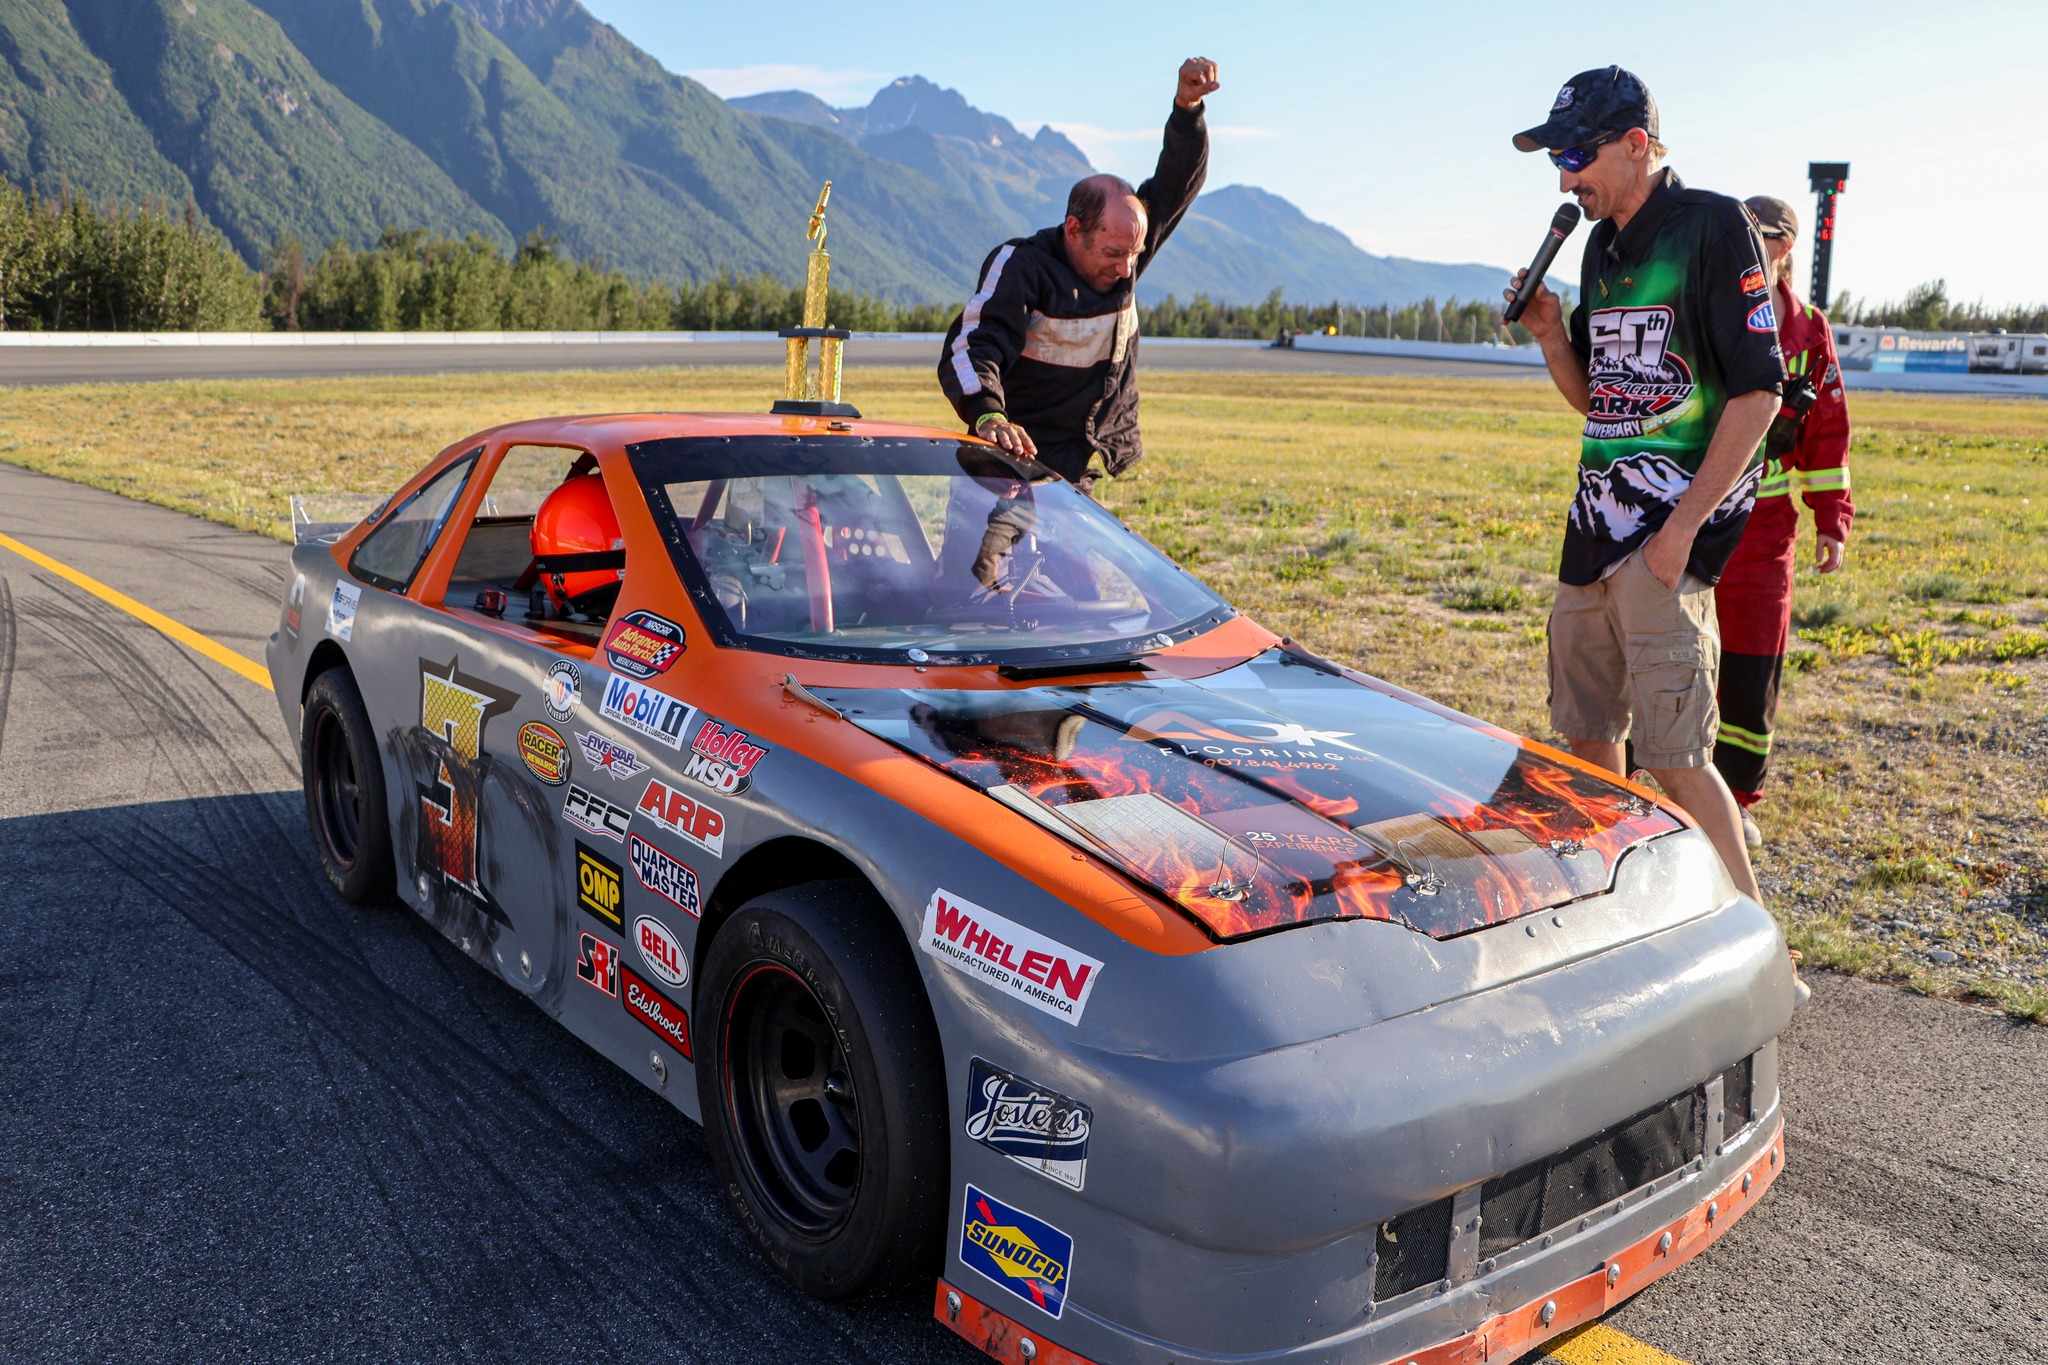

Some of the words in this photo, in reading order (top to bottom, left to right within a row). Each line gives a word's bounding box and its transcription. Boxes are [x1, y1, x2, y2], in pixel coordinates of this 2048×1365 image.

[1753, 306, 1776, 328] NH
[1898, 335, 1966, 352] Rewards
[1588, 396, 1664, 417] ARK
[619, 627, 660, 651] Advance
[645, 619, 673, 636] NASCAR
[609, 637, 631, 653] Auto
[628, 643, 652, 661] Parts
[615, 655, 633, 668] WEEKLY
[632, 661, 648, 674] SERIES
[606, 677, 666, 728] Mobil
[604, 707, 622, 720] OFFICIAL
[622, 715, 638, 729] MOTOR
[636, 721, 645, 731] OIL
[648, 727, 677, 746] LUBRICANTS
[524, 731, 560, 760] RACER
[526, 751, 558, 774] REWARDS
[587, 734, 610, 754] FIVE
[612, 745, 635, 768] STAR
[692, 720, 767, 778] Holley
[1159, 744, 1344, 762] FLOORING
[683, 754, 741, 793] MSD
[1203, 757, 1341, 772] 907.841.4982
[564, 807, 596, 828] BRAKES
[566, 785, 631, 836] PFC
[639, 780, 724, 842] ARP
[1245, 831, 1277, 841] 25
[1280, 832, 1359, 848] YEARS
[1252, 840, 1359, 856] EXPERIENCE
[631, 837, 696, 894] QUARTER
[580, 863, 620, 912] OMP
[641, 860, 698, 915] MASTER
[577, 934, 617, 996] SRI
[641, 923, 682, 976] BELL
[645, 951, 677, 981] HELMETS
[935, 896, 1093, 1002] WHELEN
[931, 937, 1010, 982] MANUFACTURED
[1010, 977, 1024, 991] IN
[1023, 984, 1073, 1015] AMERICA
[628, 983, 685, 1044] Edelbrock
[967, 1075, 1088, 1139] Jostens
[1044, 1163, 1064, 1177] SINCE
[1063, 1172, 1077, 1183] 1897
[969, 1222, 1061, 1282] SUNOCO
